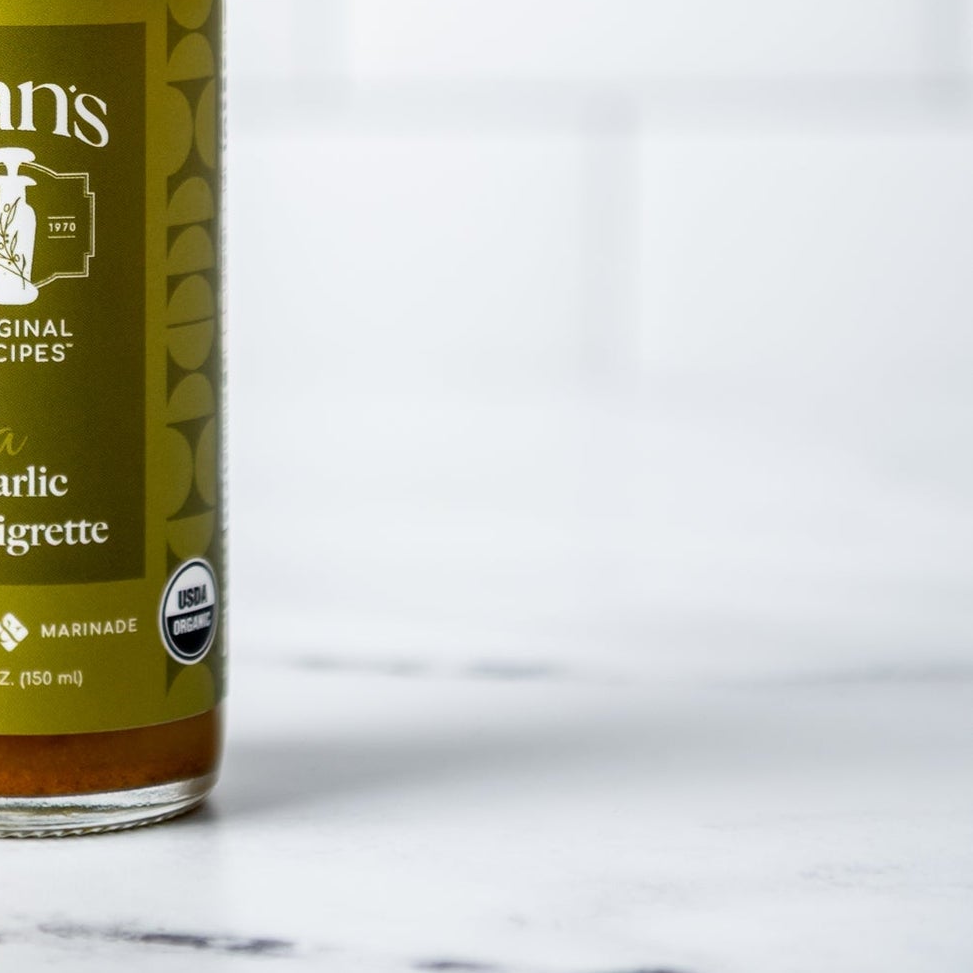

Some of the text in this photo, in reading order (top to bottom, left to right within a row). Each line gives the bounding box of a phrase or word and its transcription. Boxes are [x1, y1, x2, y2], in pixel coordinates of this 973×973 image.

[47, 221, 77, 233] 1970
[177, 584, 208, 609] USDA
[40, 618, 139, 639] MARINADE
[20, 671, 52, 689] (150
[58, 670, 83, 688] ml)
